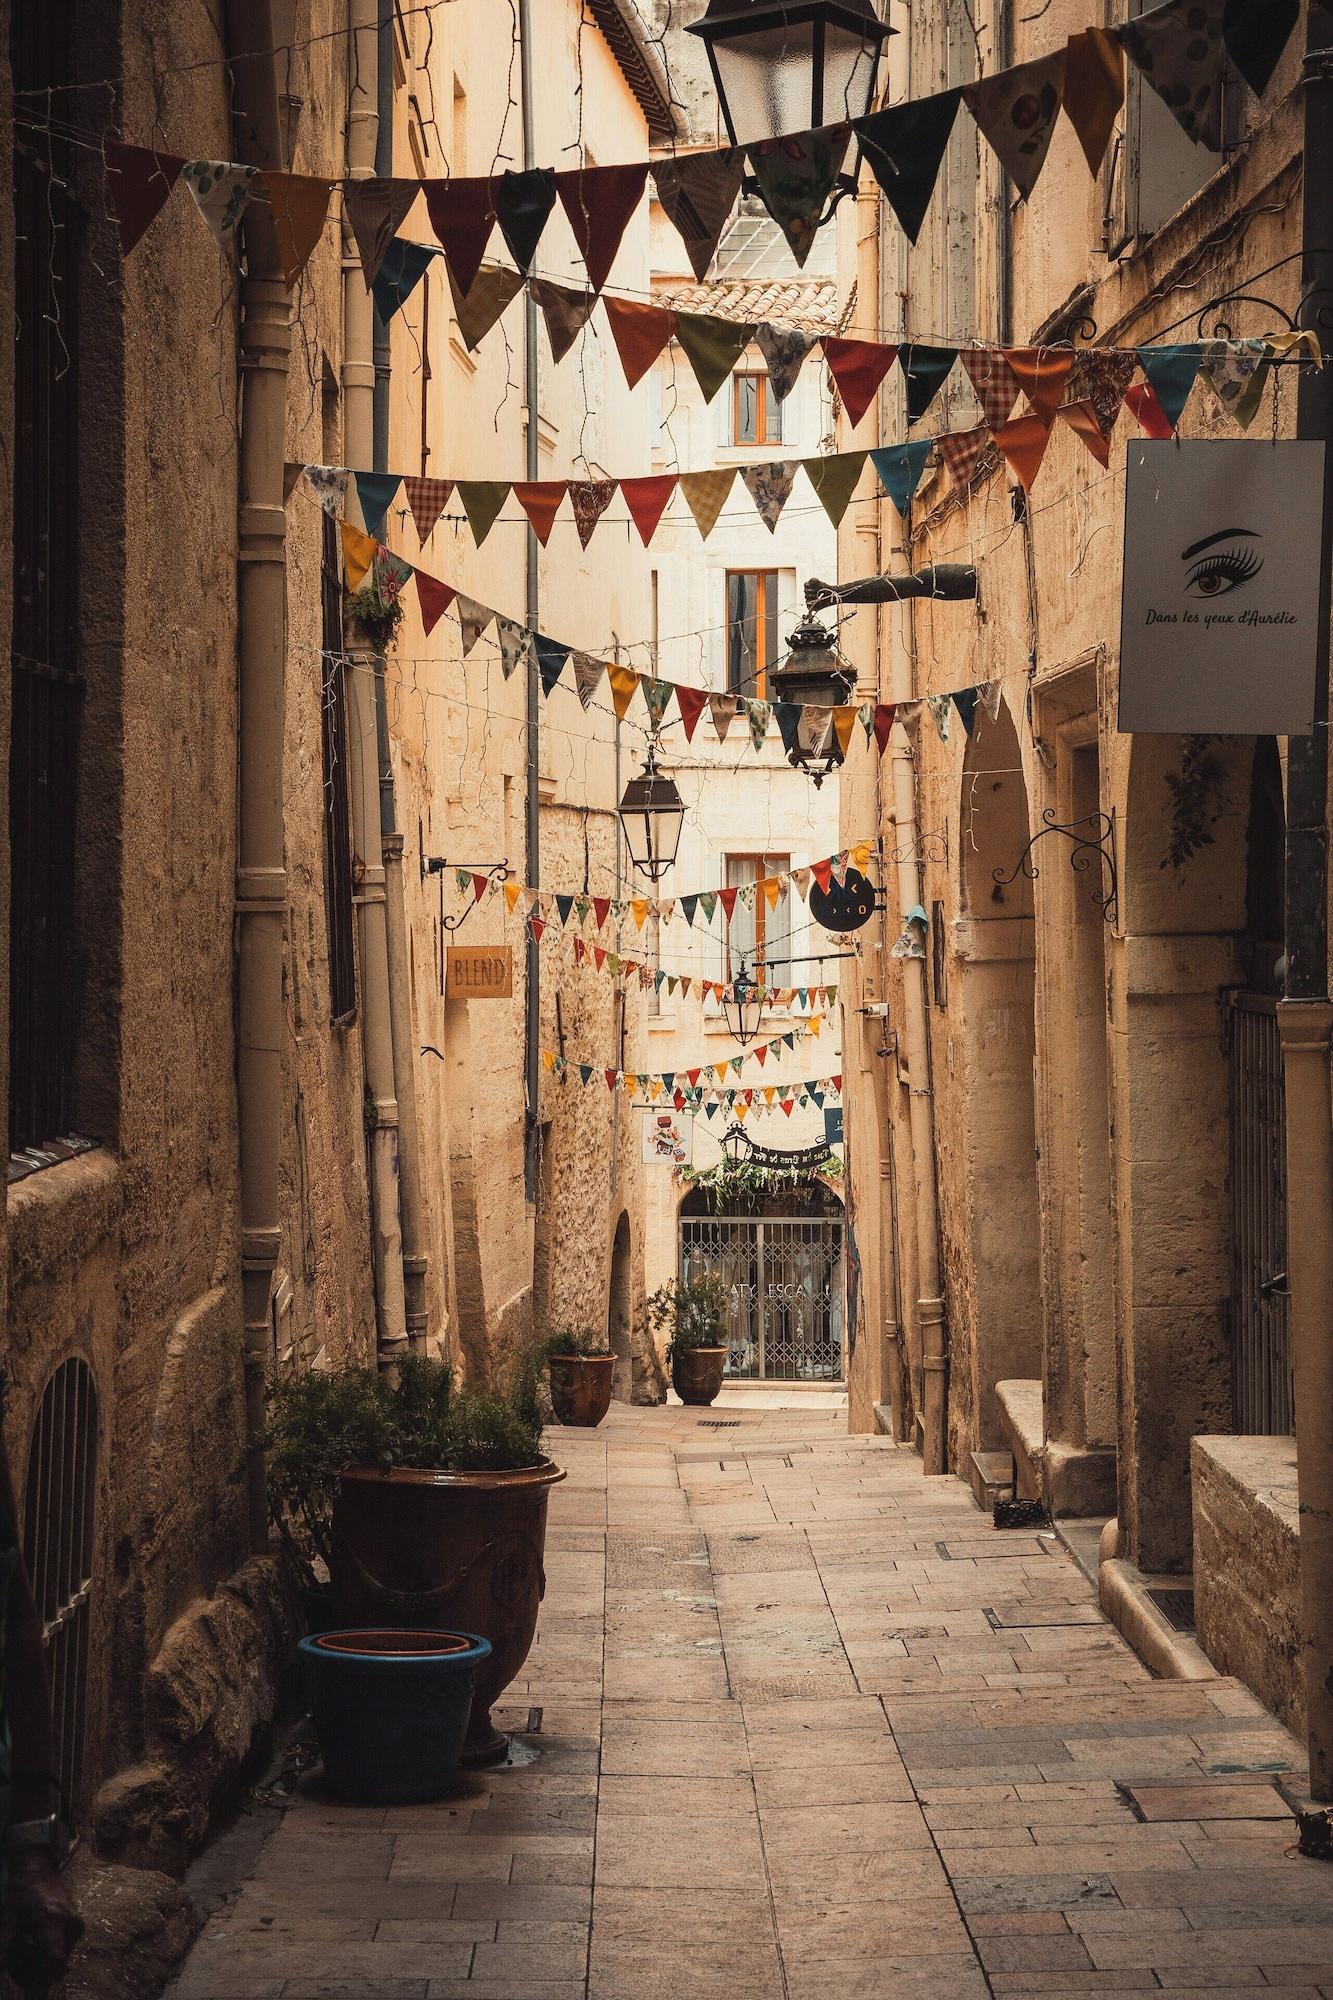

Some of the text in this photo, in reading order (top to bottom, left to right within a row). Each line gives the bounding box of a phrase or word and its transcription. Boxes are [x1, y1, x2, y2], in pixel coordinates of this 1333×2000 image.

[1145, 609, 1298, 629] Dans les yeux d'Aurélie
[455, 959, 505, 986] BLEND
